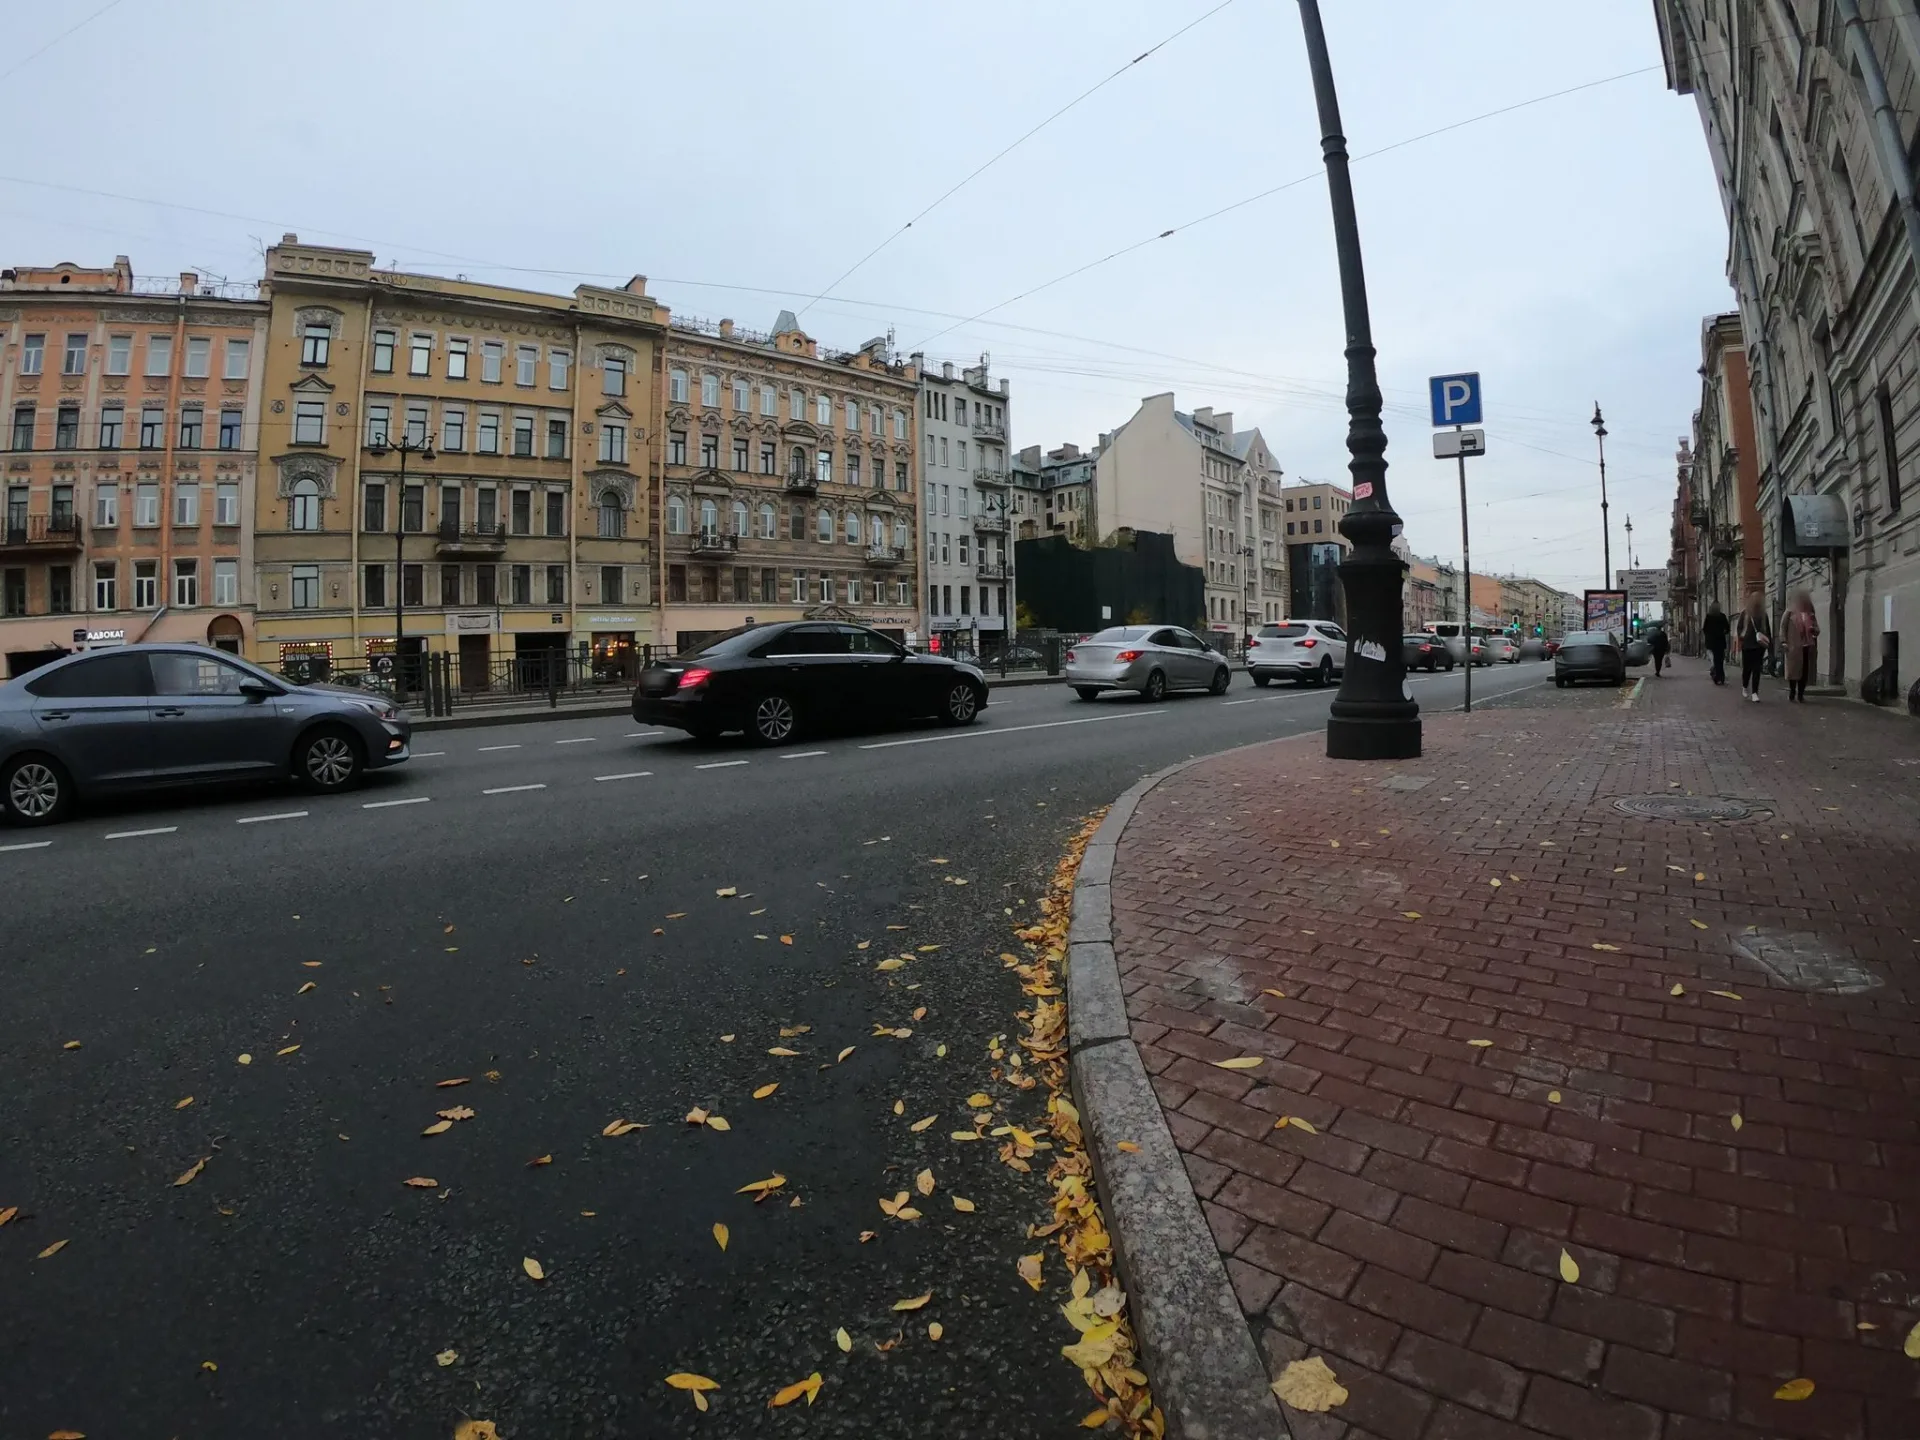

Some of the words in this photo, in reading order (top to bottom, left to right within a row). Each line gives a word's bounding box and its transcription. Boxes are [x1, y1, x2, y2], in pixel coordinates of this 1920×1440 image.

[1443, 380, 1471, 420] P
[87, 630, 125, 640] АДВОКАТ
[285, 645, 328, 654] КРОССОВКИ
